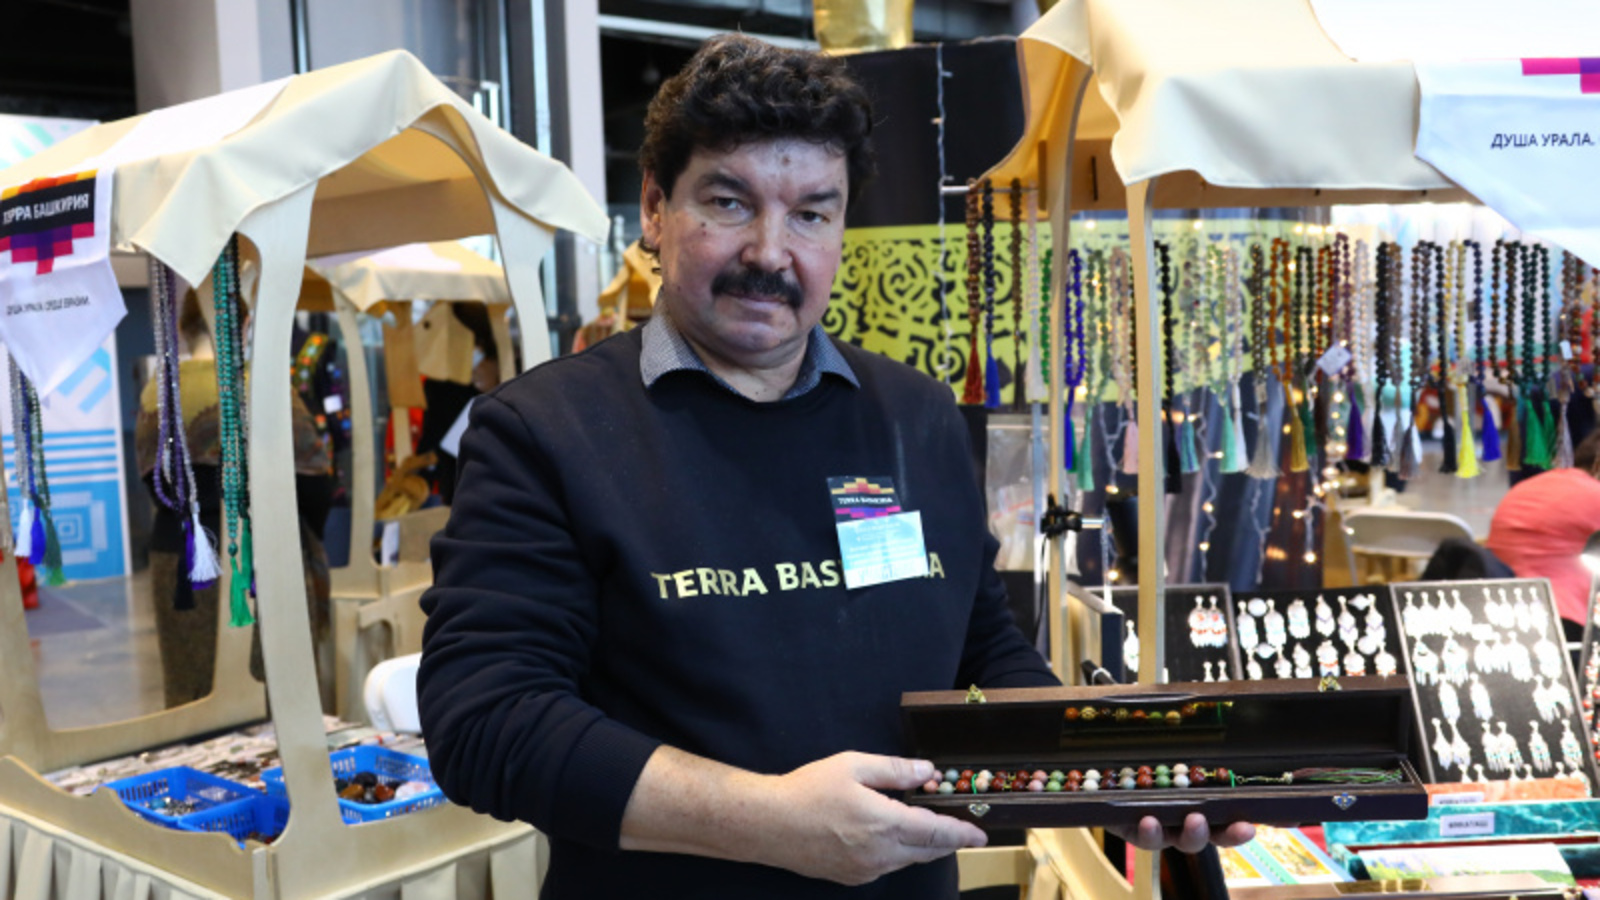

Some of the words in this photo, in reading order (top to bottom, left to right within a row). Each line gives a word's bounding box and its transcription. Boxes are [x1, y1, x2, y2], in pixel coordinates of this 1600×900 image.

[1490, 133, 1538, 150] ДУША
[1541, 132, 1595, 147] УРАЛА.
[33, 193, 89, 219] БАШКИРИЯ
[651, 567, 768, 599] TERRA
